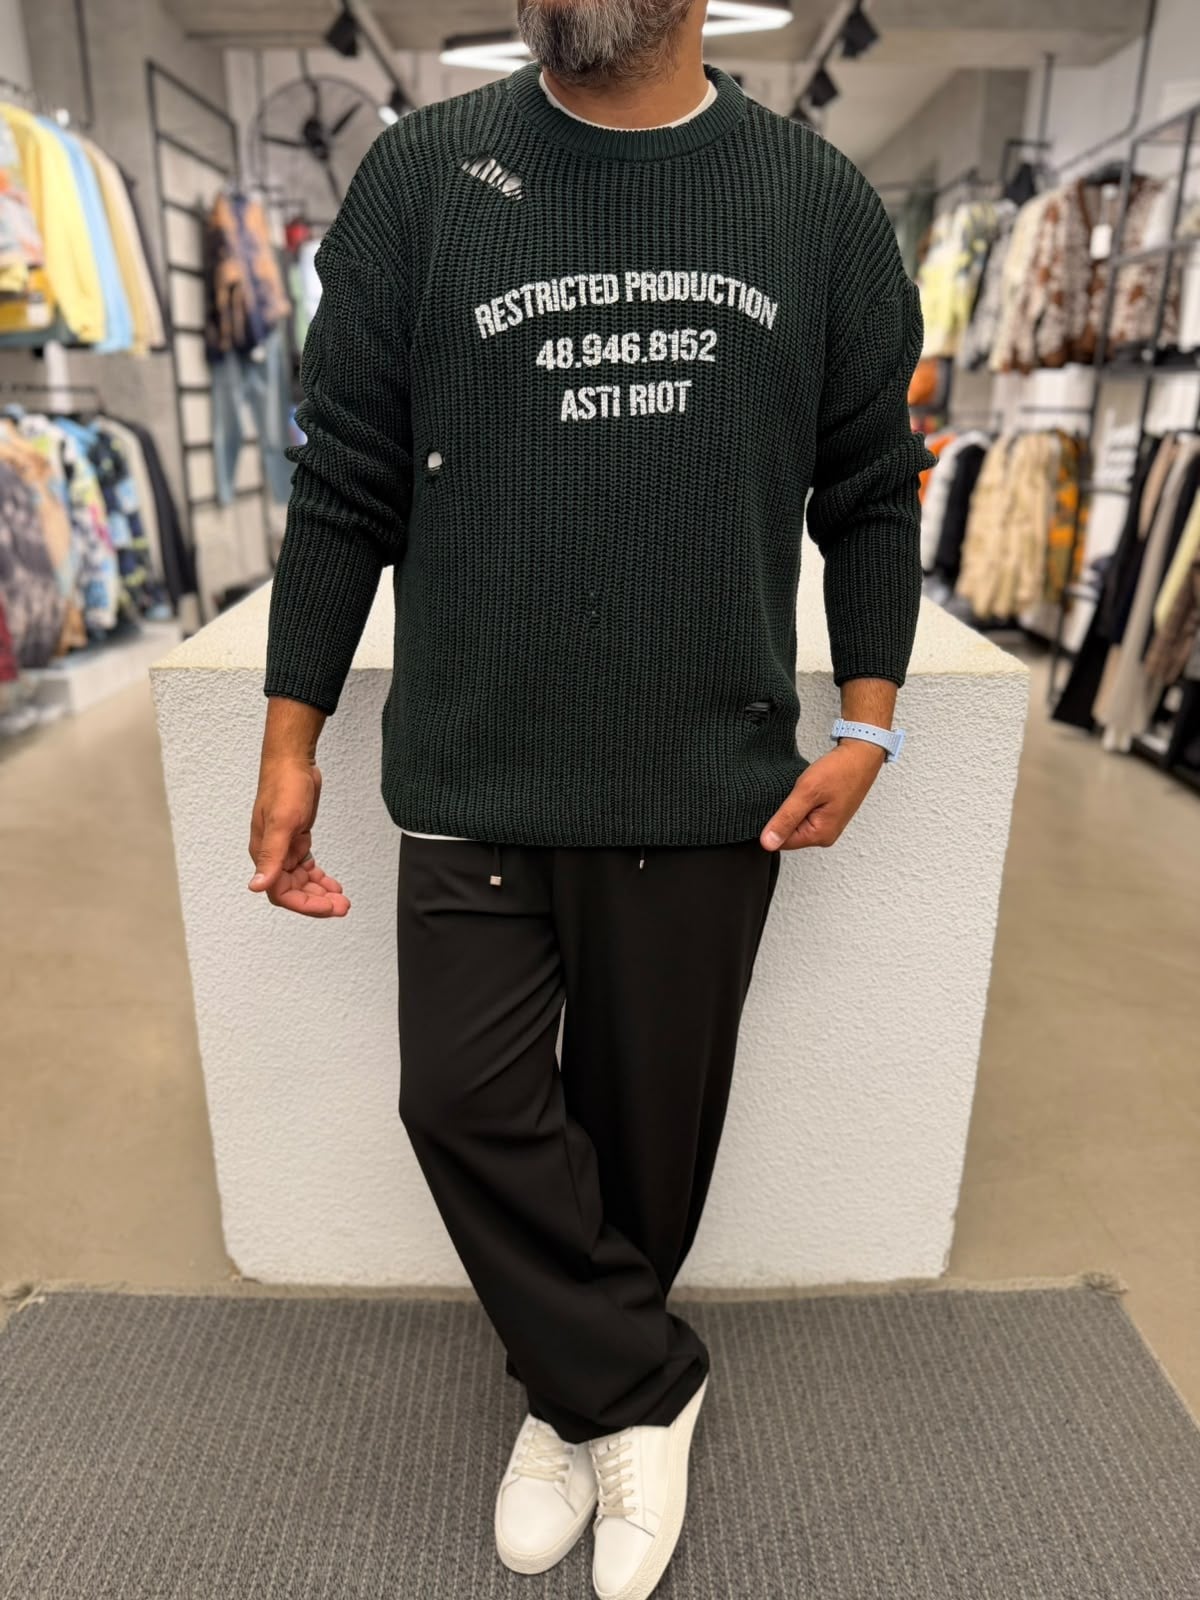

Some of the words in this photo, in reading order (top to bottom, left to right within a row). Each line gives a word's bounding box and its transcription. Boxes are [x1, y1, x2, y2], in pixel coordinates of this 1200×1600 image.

[475, 273, 619, 339] RESTRICTED
[625, 271, 778, 330] PRODUCTION
[536, 328, 718, 370] 48.946.8152
[561, 386, 621, 421] ASTI
[630, 380, 692, 416] RIOT
